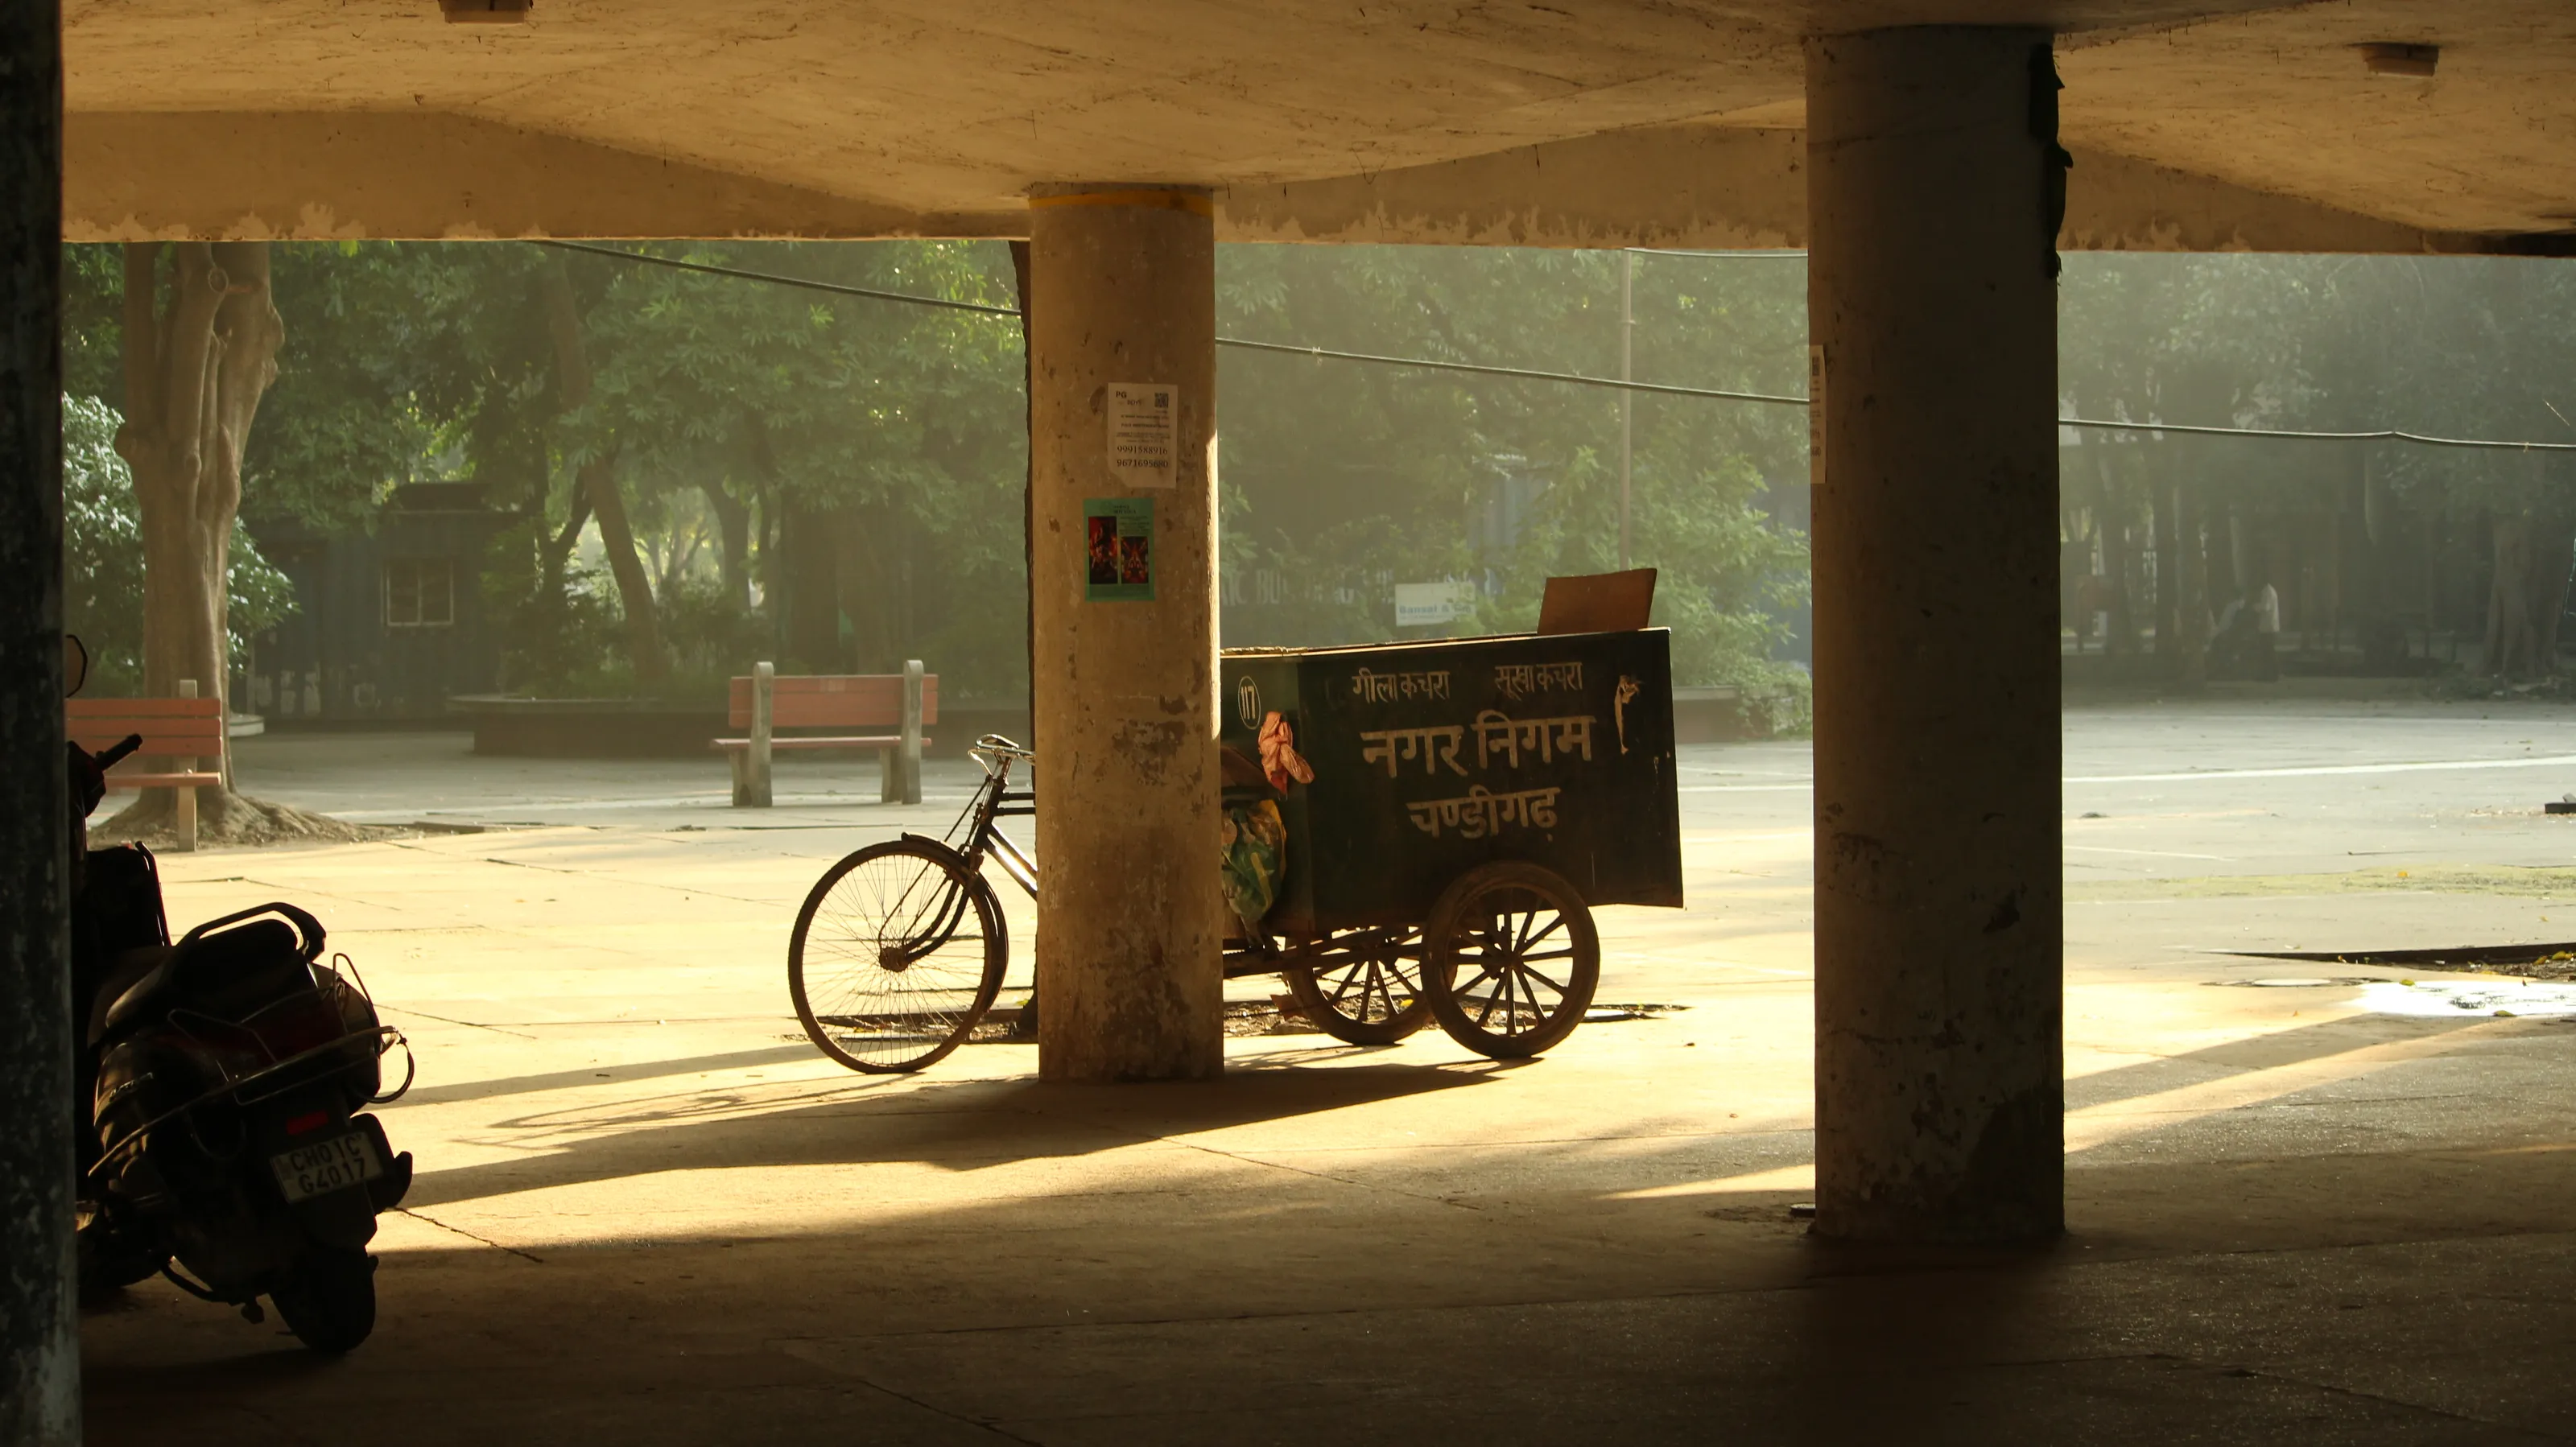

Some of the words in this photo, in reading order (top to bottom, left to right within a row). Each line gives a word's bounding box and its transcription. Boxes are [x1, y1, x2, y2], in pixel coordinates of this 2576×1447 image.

[1399, 604, 1437, 613] Bansal
[1352, 667, 1398, 703] गीला
[1400, 671, 1451, 700] कचरा
[1495, 664, 1534, 701] सूखा
[1536, 662, 1583, 691] कचरा
[1241, 685, 1256, 719] 117
[1360, 725, 1468, 778] नगर
[1470, 709, 1597, 769] निगम
[1406, 785, 1562, 842] चण्डीगढ़
